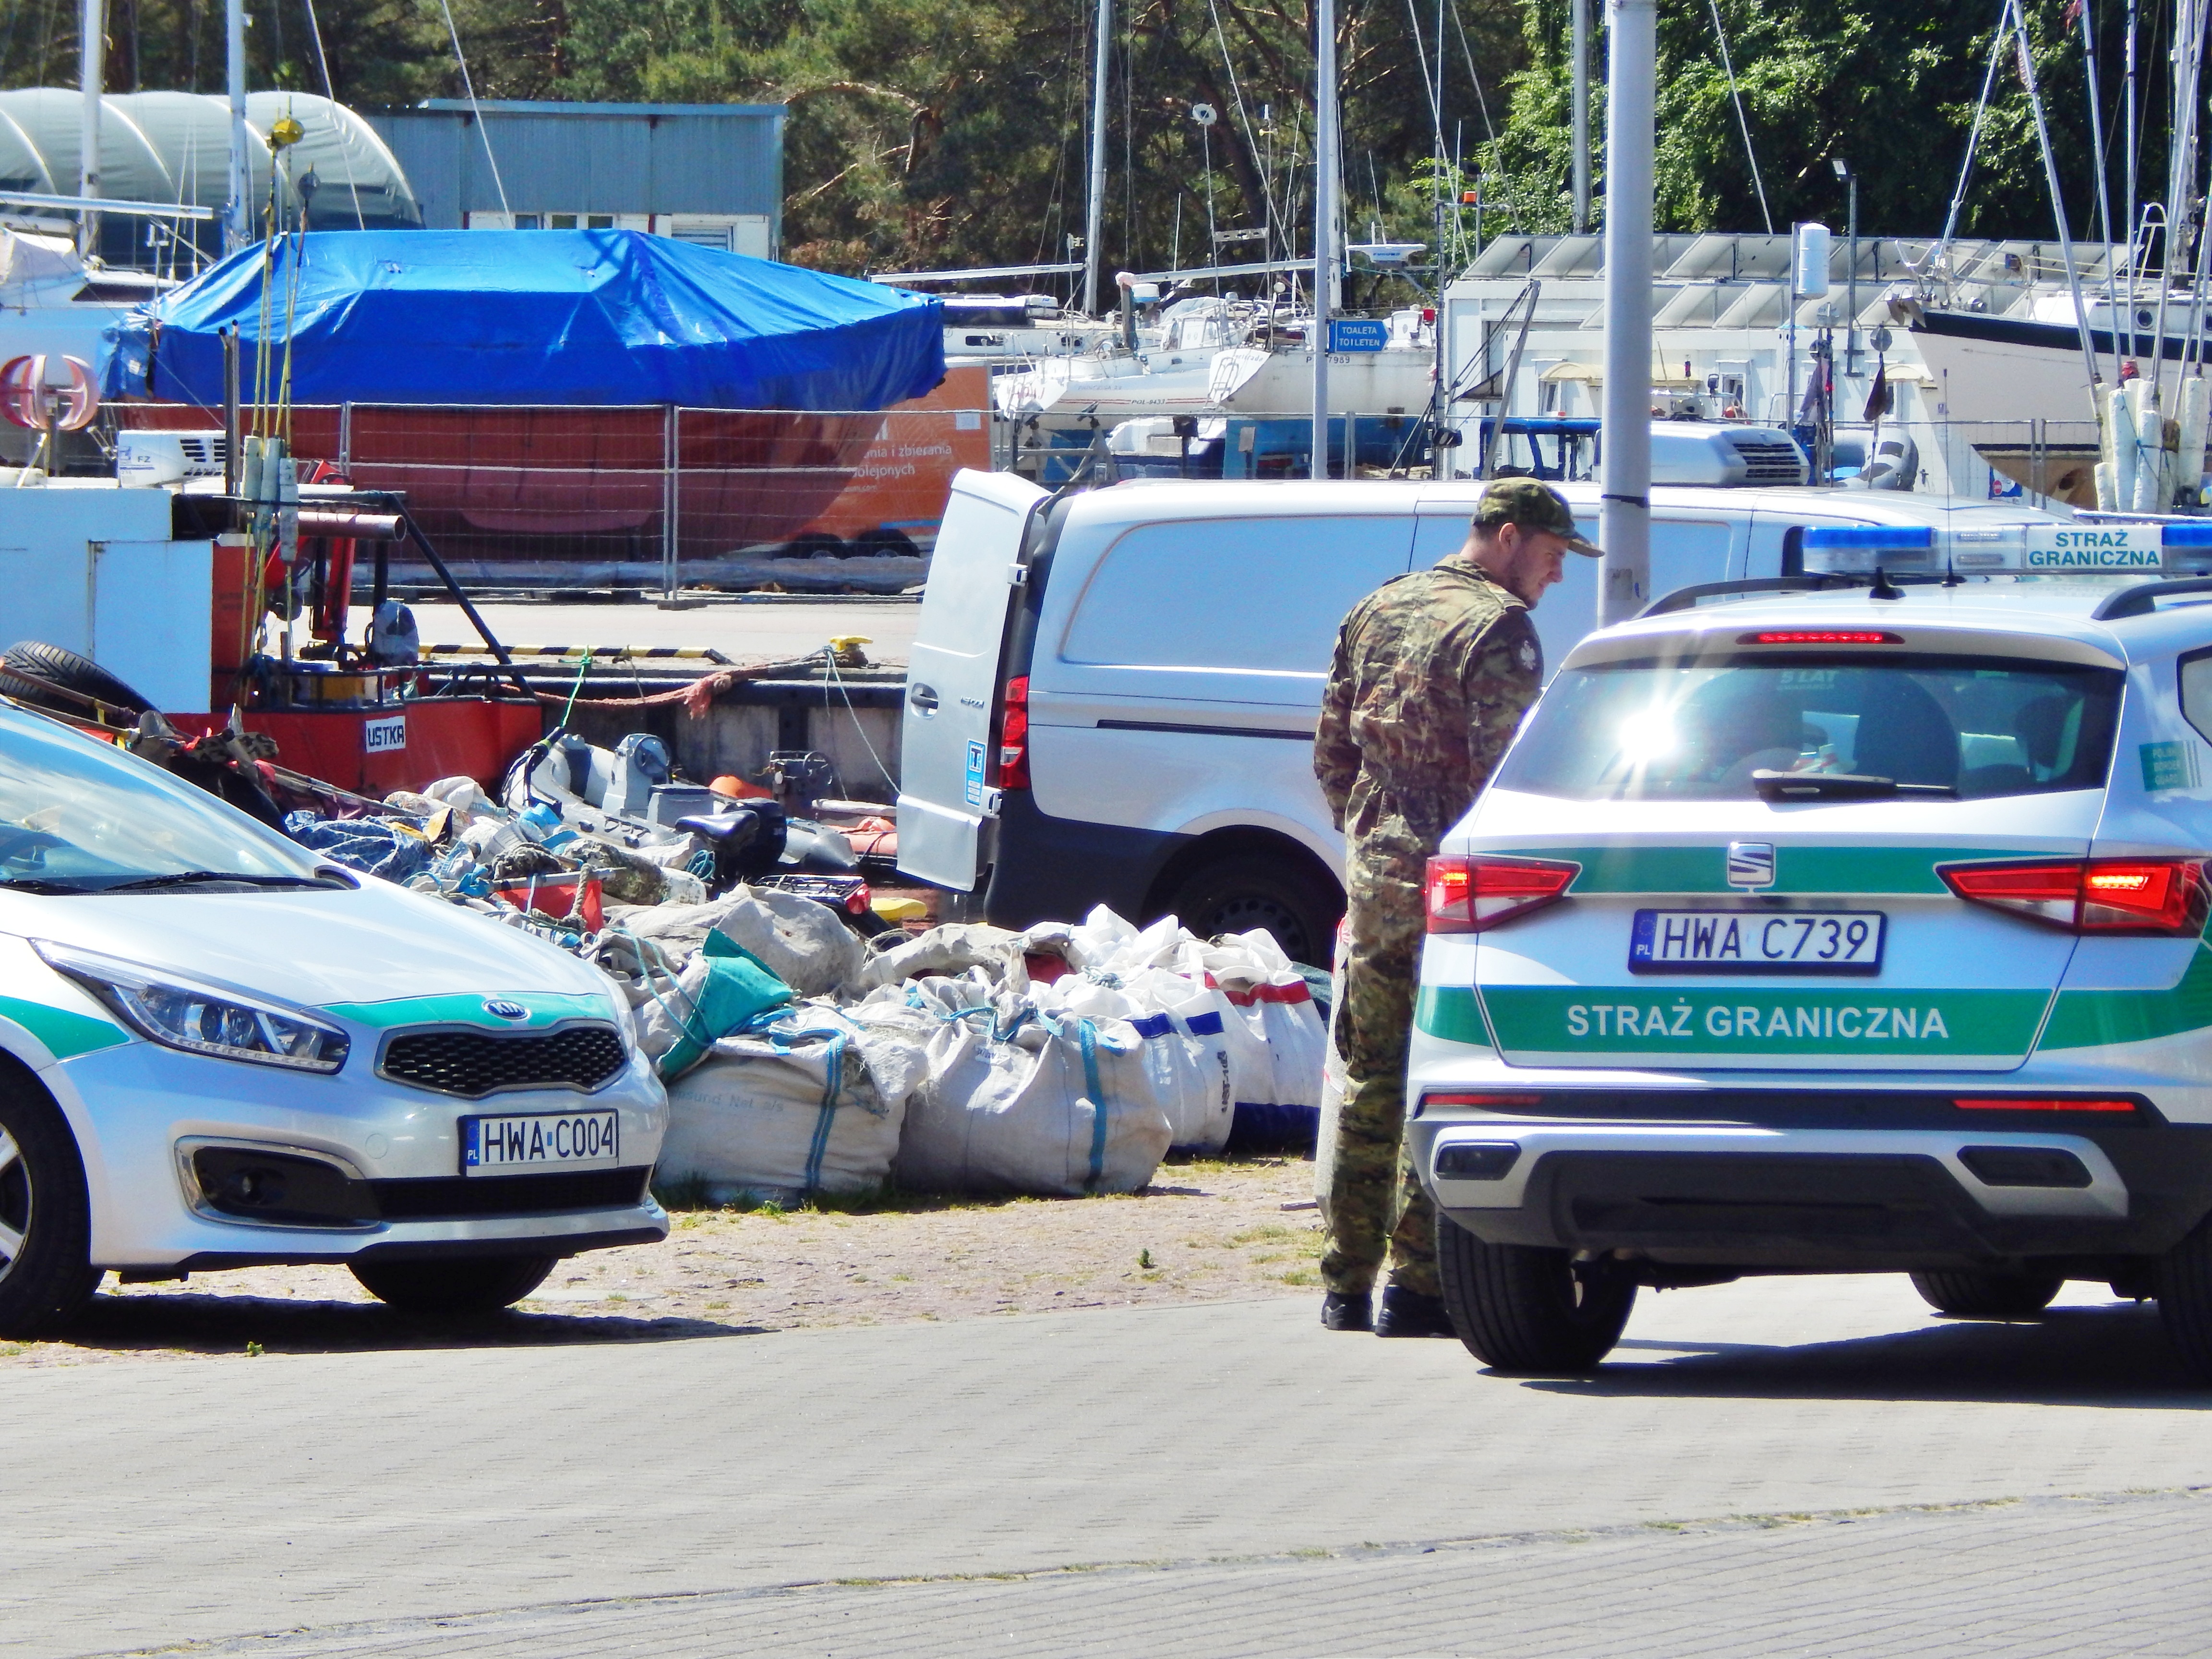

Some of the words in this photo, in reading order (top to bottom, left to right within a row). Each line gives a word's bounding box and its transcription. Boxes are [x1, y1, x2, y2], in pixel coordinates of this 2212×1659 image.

[1339, 337, 1380, 346] TOILETEN
[891, 445, 895, 457] i
[899, 444, 952, 457] zbierania
[2056, 529, 2128, 547] STRAŻ
[2029, 551, 2160, 565] GRANICZNA
[368, 725, 404, 746] USTKA
[1636, 944, 1650, 956] PL
[1662, 918, 1741, 958] HWA
[1762, 919, 1869, 959] C739
[490, 1002, 524, 1013] KIA
[1567, 998, 1693, 1036] STRAŻ
[1706, 1006, 1949, 1038] GRANICZNA
[468, 1149, 478, 1160] PL
[485, 1121, 545, 1162] HWA
[556, 1117, 613, 1157] C004
